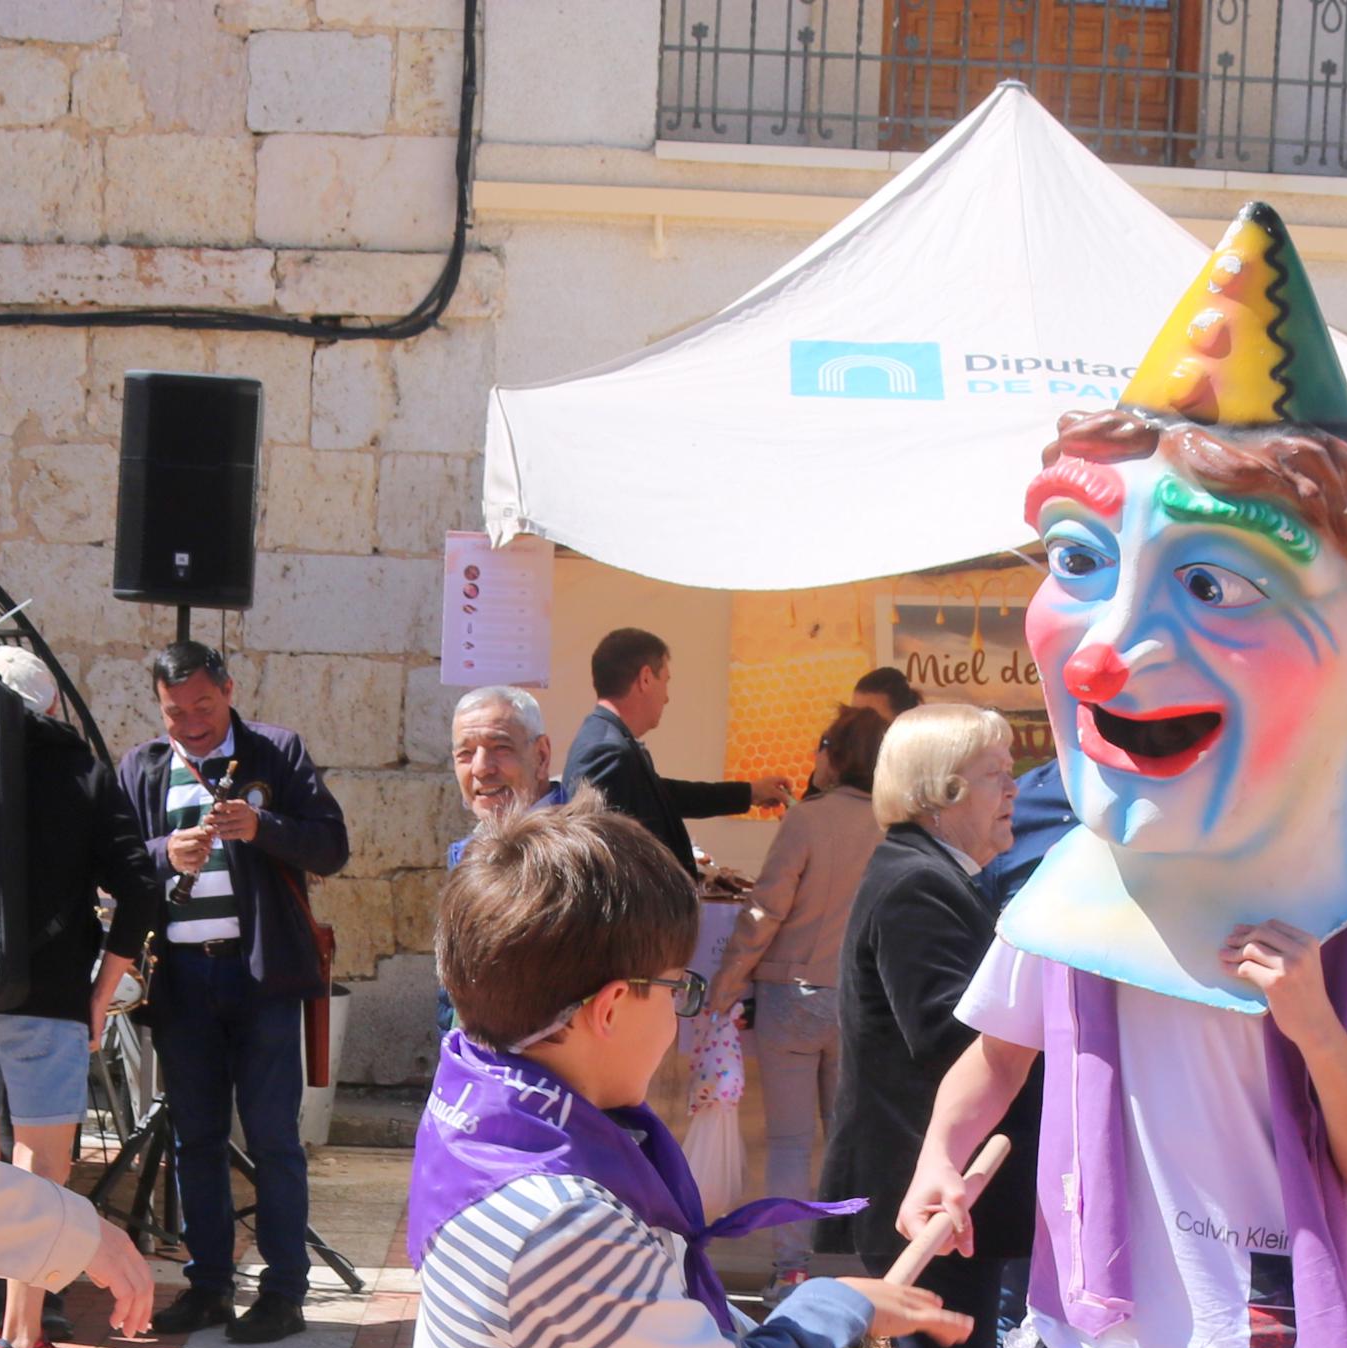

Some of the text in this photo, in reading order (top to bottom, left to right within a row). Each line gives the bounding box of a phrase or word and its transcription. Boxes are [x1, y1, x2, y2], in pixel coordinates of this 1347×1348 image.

[964, 353, 1140, 380] Diputac
[967, 379, 1033, 394] DE
[906, 649, 1041, 687] Miel de
[1175, 1210, 1240, 1247] Calvin
